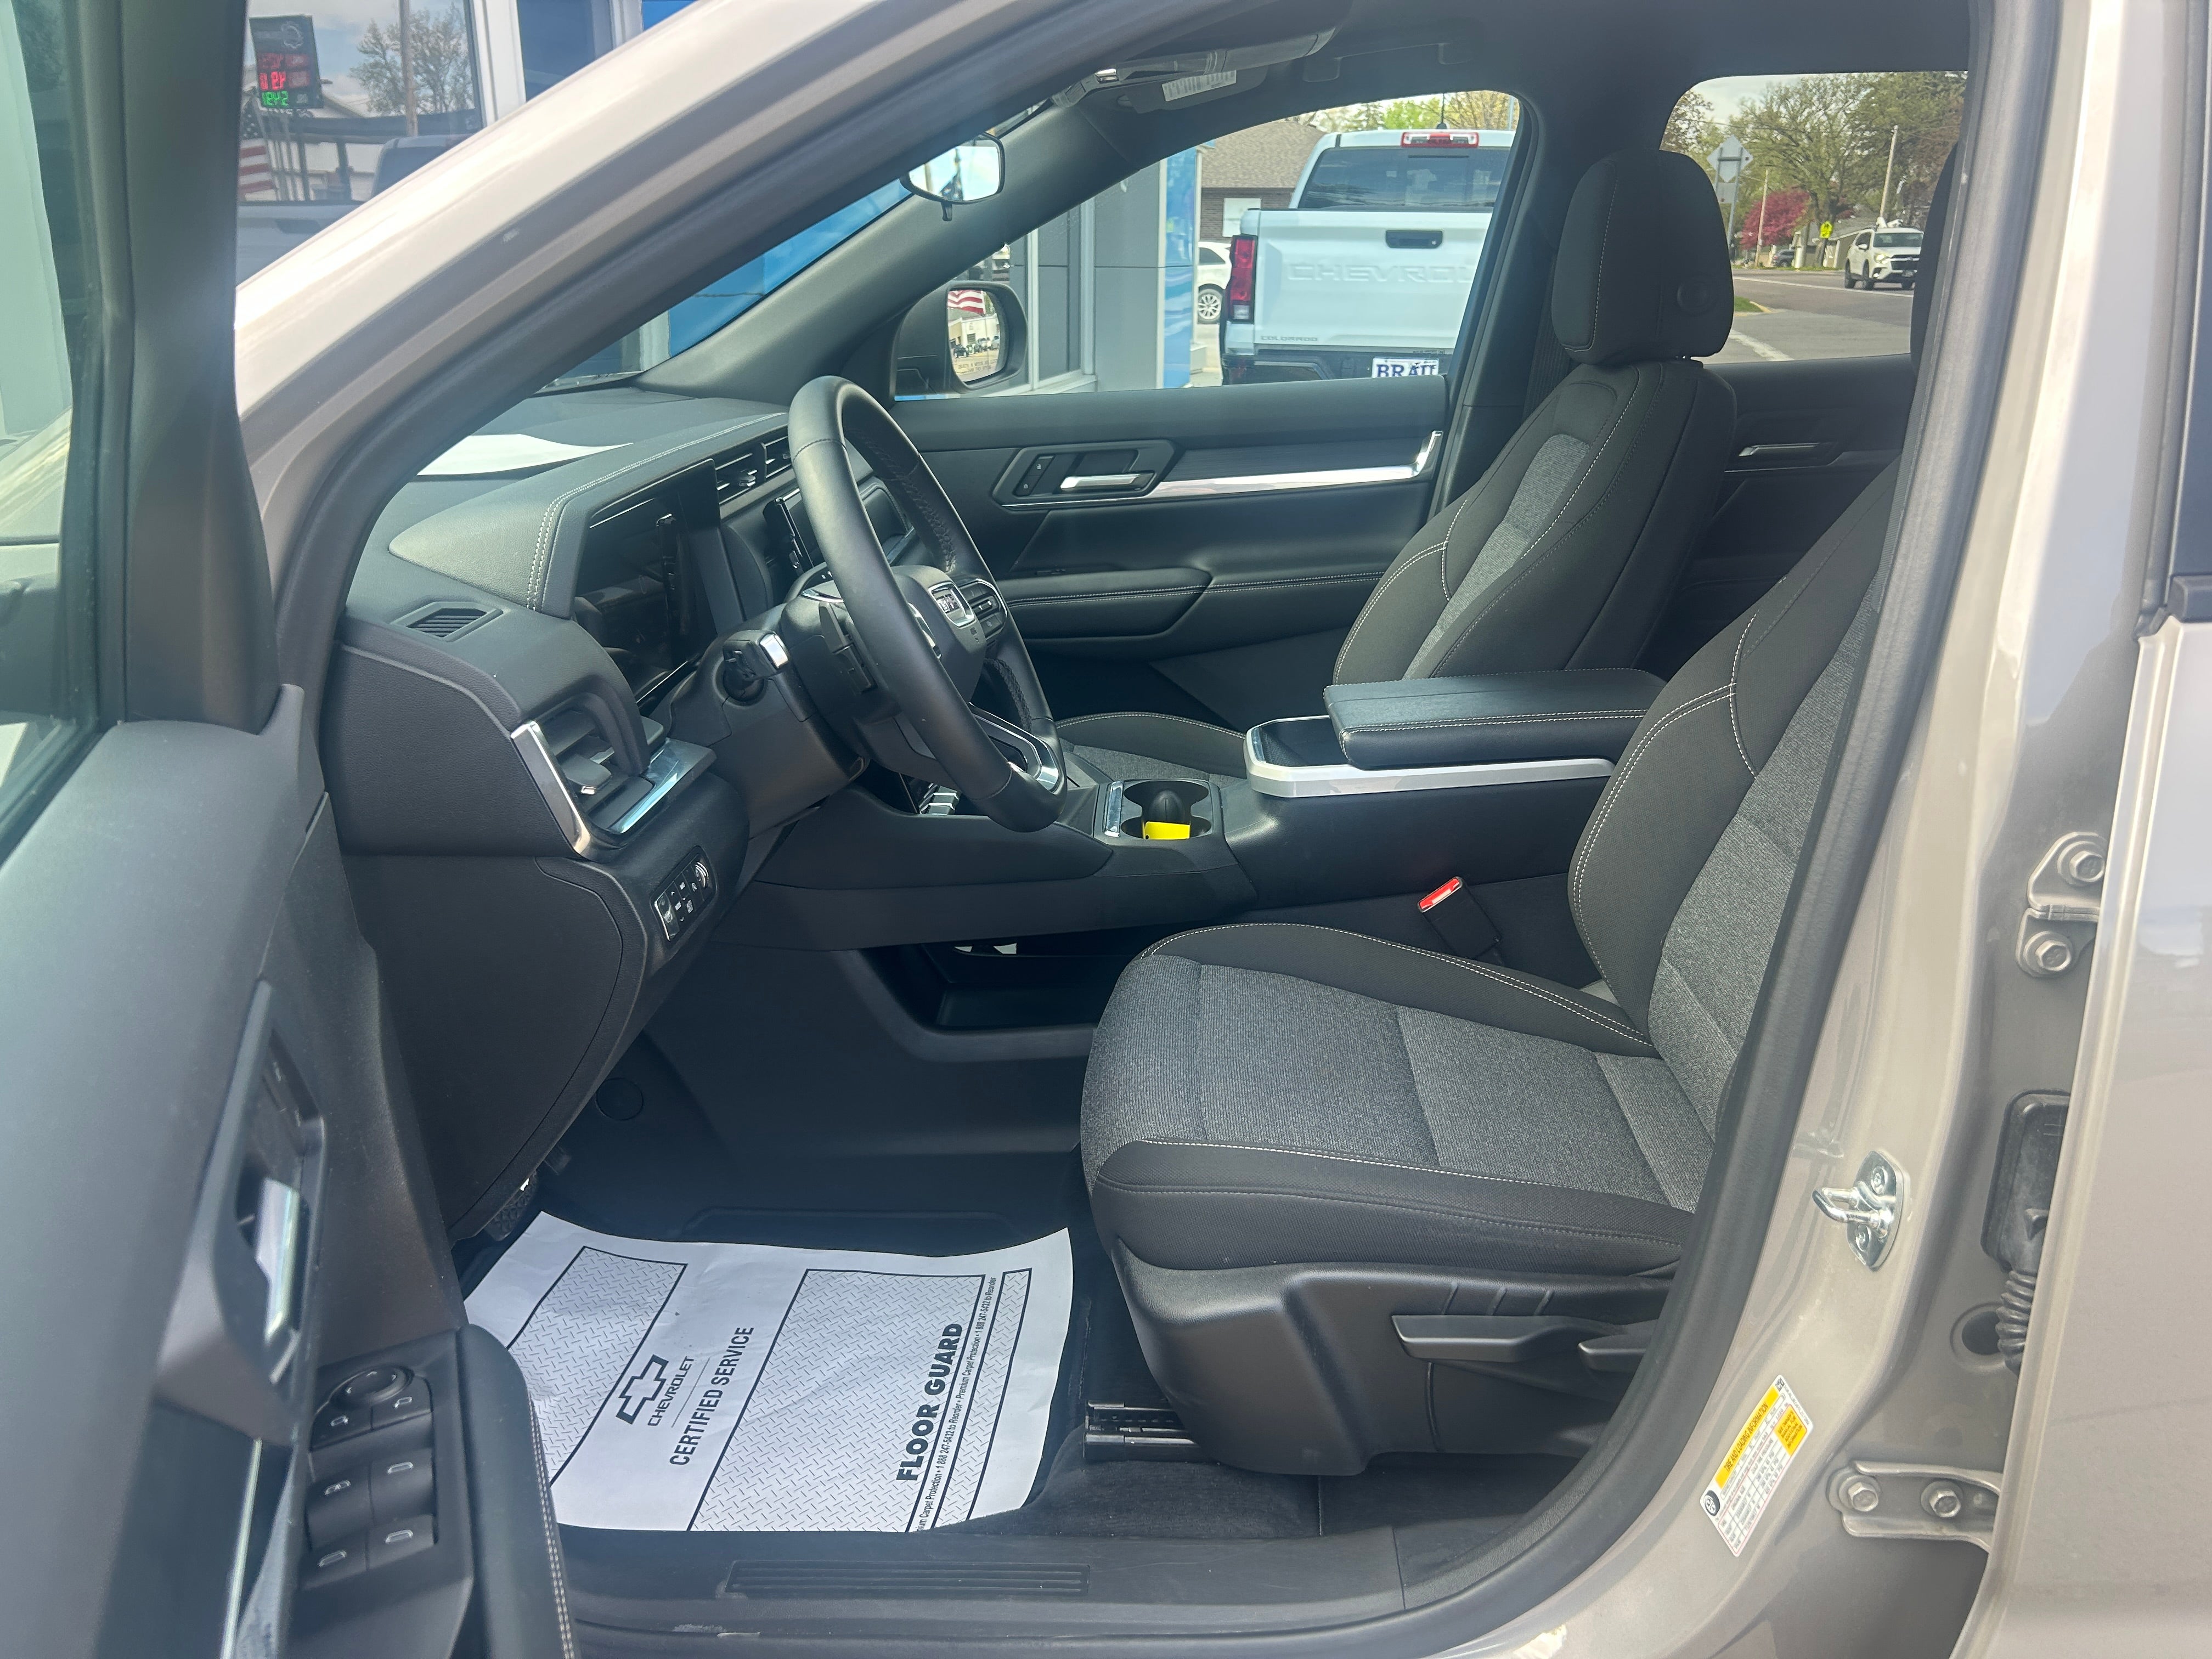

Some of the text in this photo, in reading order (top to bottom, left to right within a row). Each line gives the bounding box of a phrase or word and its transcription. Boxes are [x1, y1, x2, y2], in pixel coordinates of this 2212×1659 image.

[985, 1277, 996, 1295] Reorder
[967, 1337, 980, 1360] Protection
[962, 1361, 974, 1375] Carpet
[647, 1356, 694, 1426] CHEVROLET
[669, 1327, 754, 1465] CERTIFIED SERVICE
[956, 1377, 969, 1398] Premium
[896, 1323, 962, 1480] FLOOR GUARD
[949, 1403, 962, 1423] Reorder
[940, 1431, 954, 1453] 247-5432
[1724, 1458, 1733, 1472] TIRE
[1736, 1430, 1751, 1454] LOADING
[1747, 1402, 1769, 1435] INFORMATION
[937, 1455, 947, 1464] 888
[926, 1474, 941, 1499] Protection
[919, 1501, 933, 1517] Carpet
